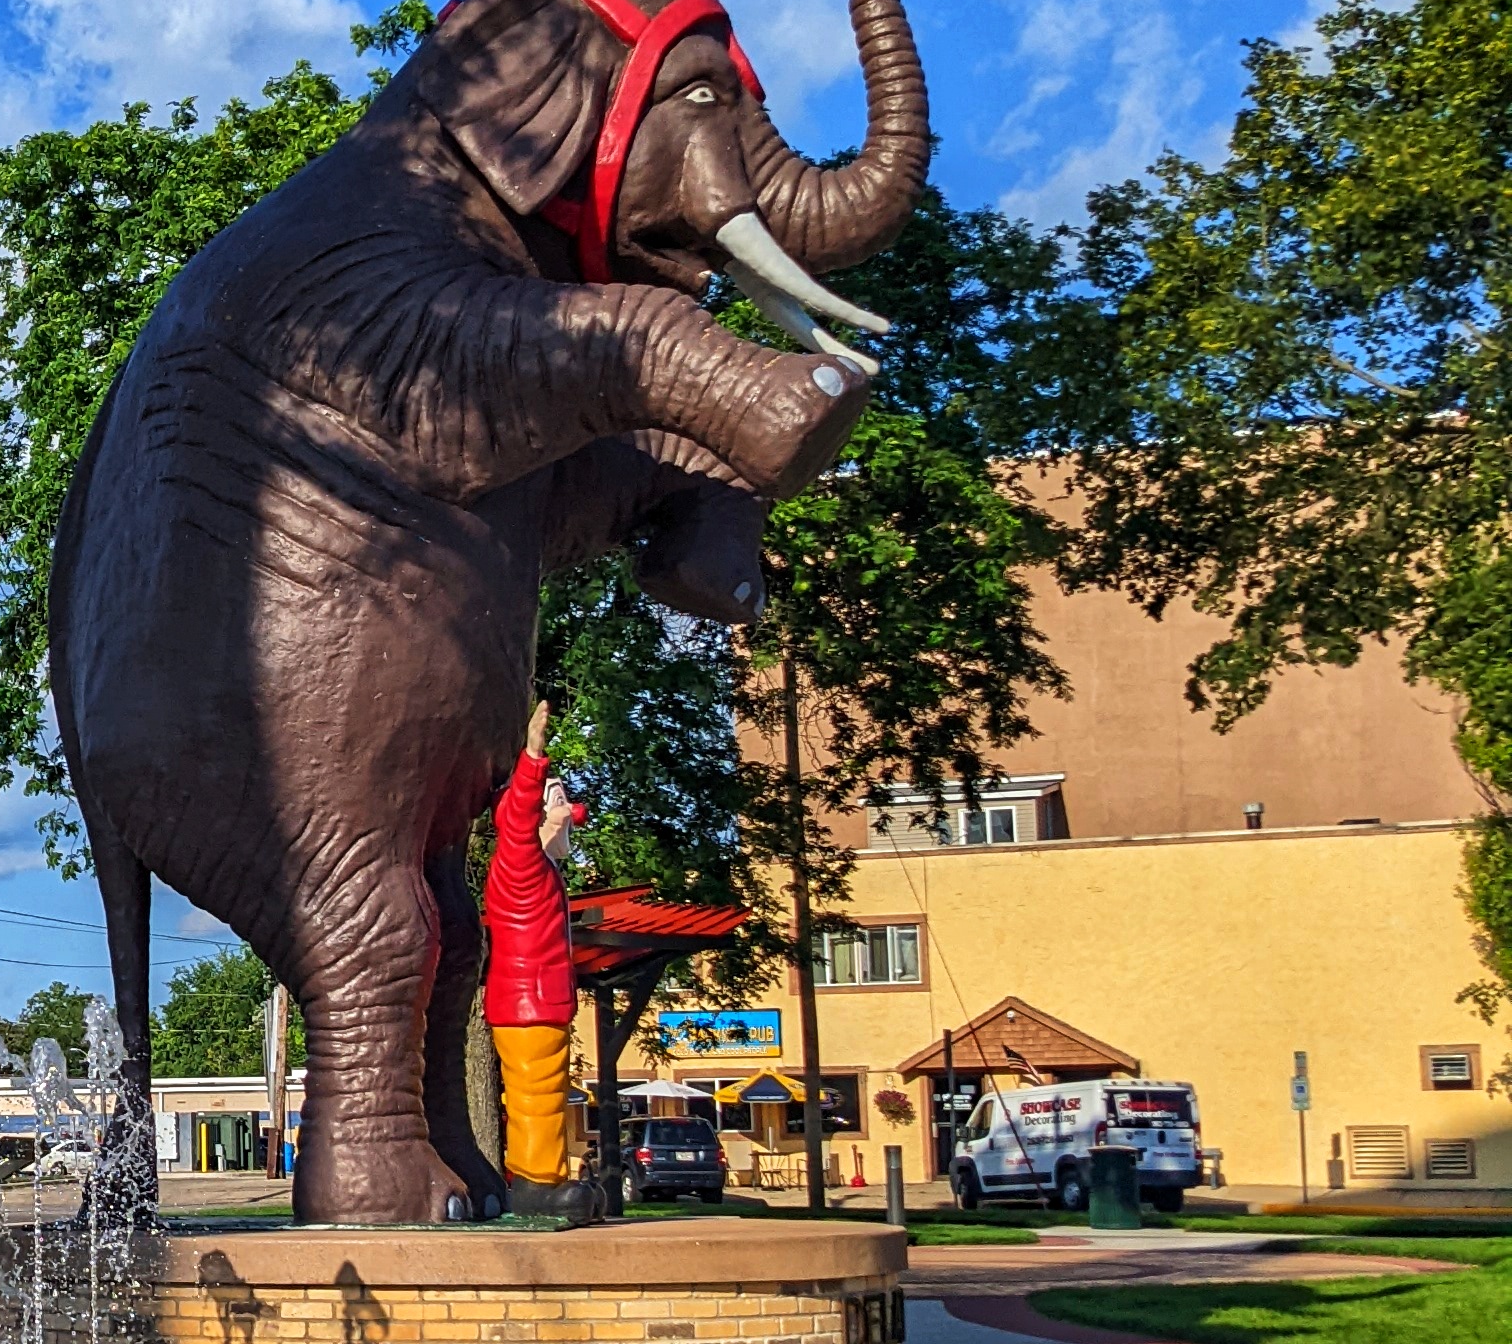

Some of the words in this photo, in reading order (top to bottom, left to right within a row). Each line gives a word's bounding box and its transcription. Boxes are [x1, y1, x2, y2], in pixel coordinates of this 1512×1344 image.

[748, 1025, 775, 1042] PUB
[1020, 1097, 1082, 1116] SHOWCASE
[1024, 1112, 1076, 1126] Decorating
